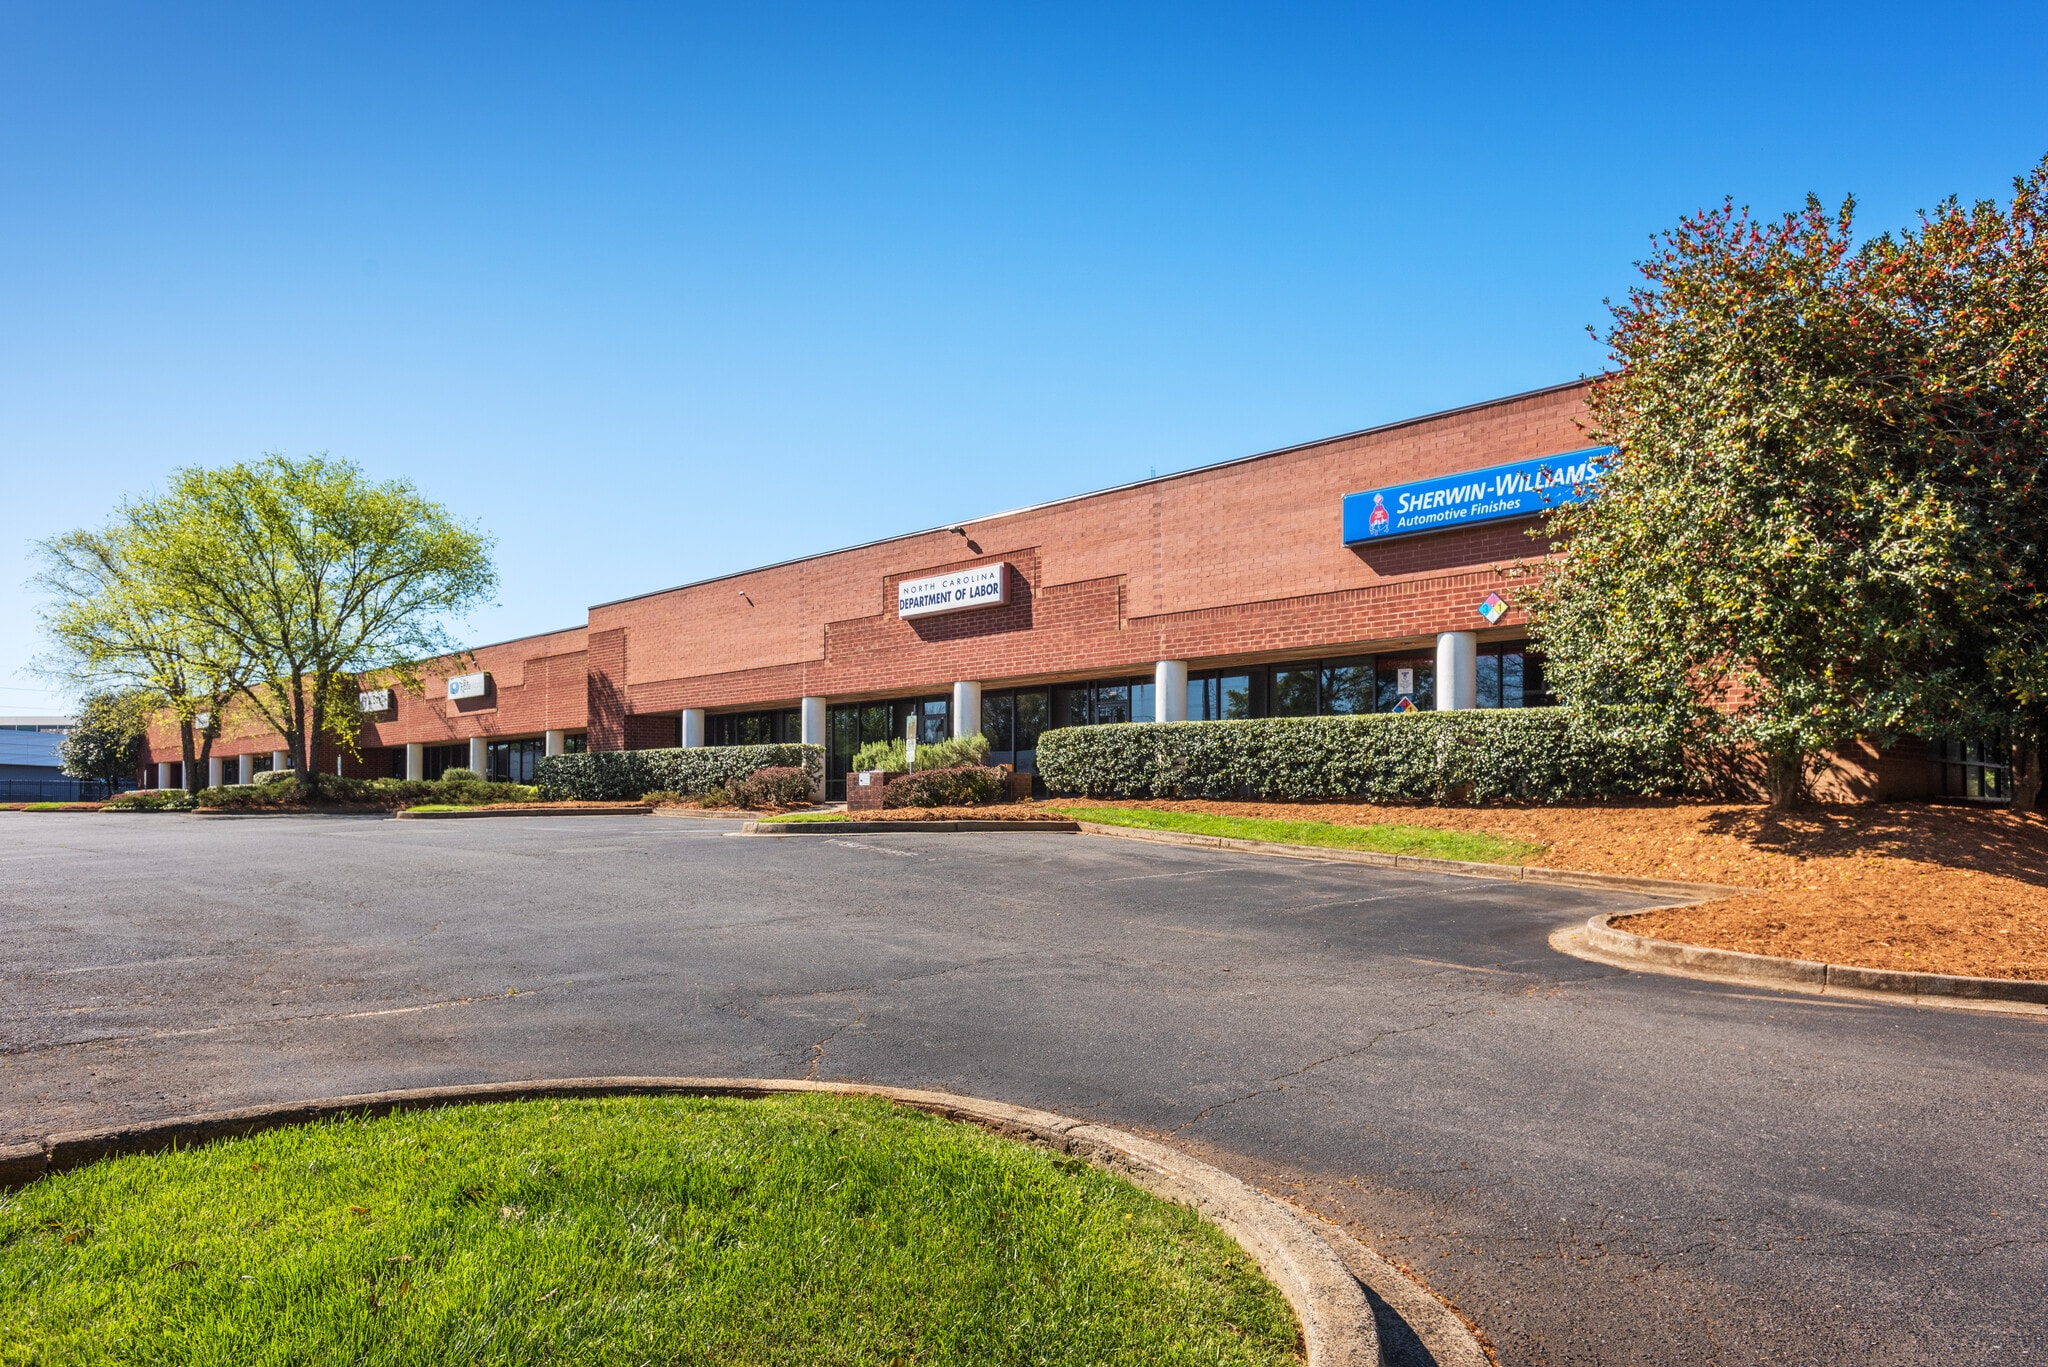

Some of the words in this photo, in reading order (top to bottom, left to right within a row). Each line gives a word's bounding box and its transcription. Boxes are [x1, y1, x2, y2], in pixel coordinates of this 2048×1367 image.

[1396, 462, 1597, 514] SHERWIN-WILLIAMS
[1396, 507, 1467, 528] Automotive
[1470, 498, 1521, 516] Finishes
[899, 591, 952, 610] DEPARTMENT
[955, 588, 967, 601] OF
[969, 582, 999, 599] LABOR
[903, 583, 935, 595] NORTH
[942, 572, 995, 588] CAROLINA
[1482, 603, 1489, 614] 3
